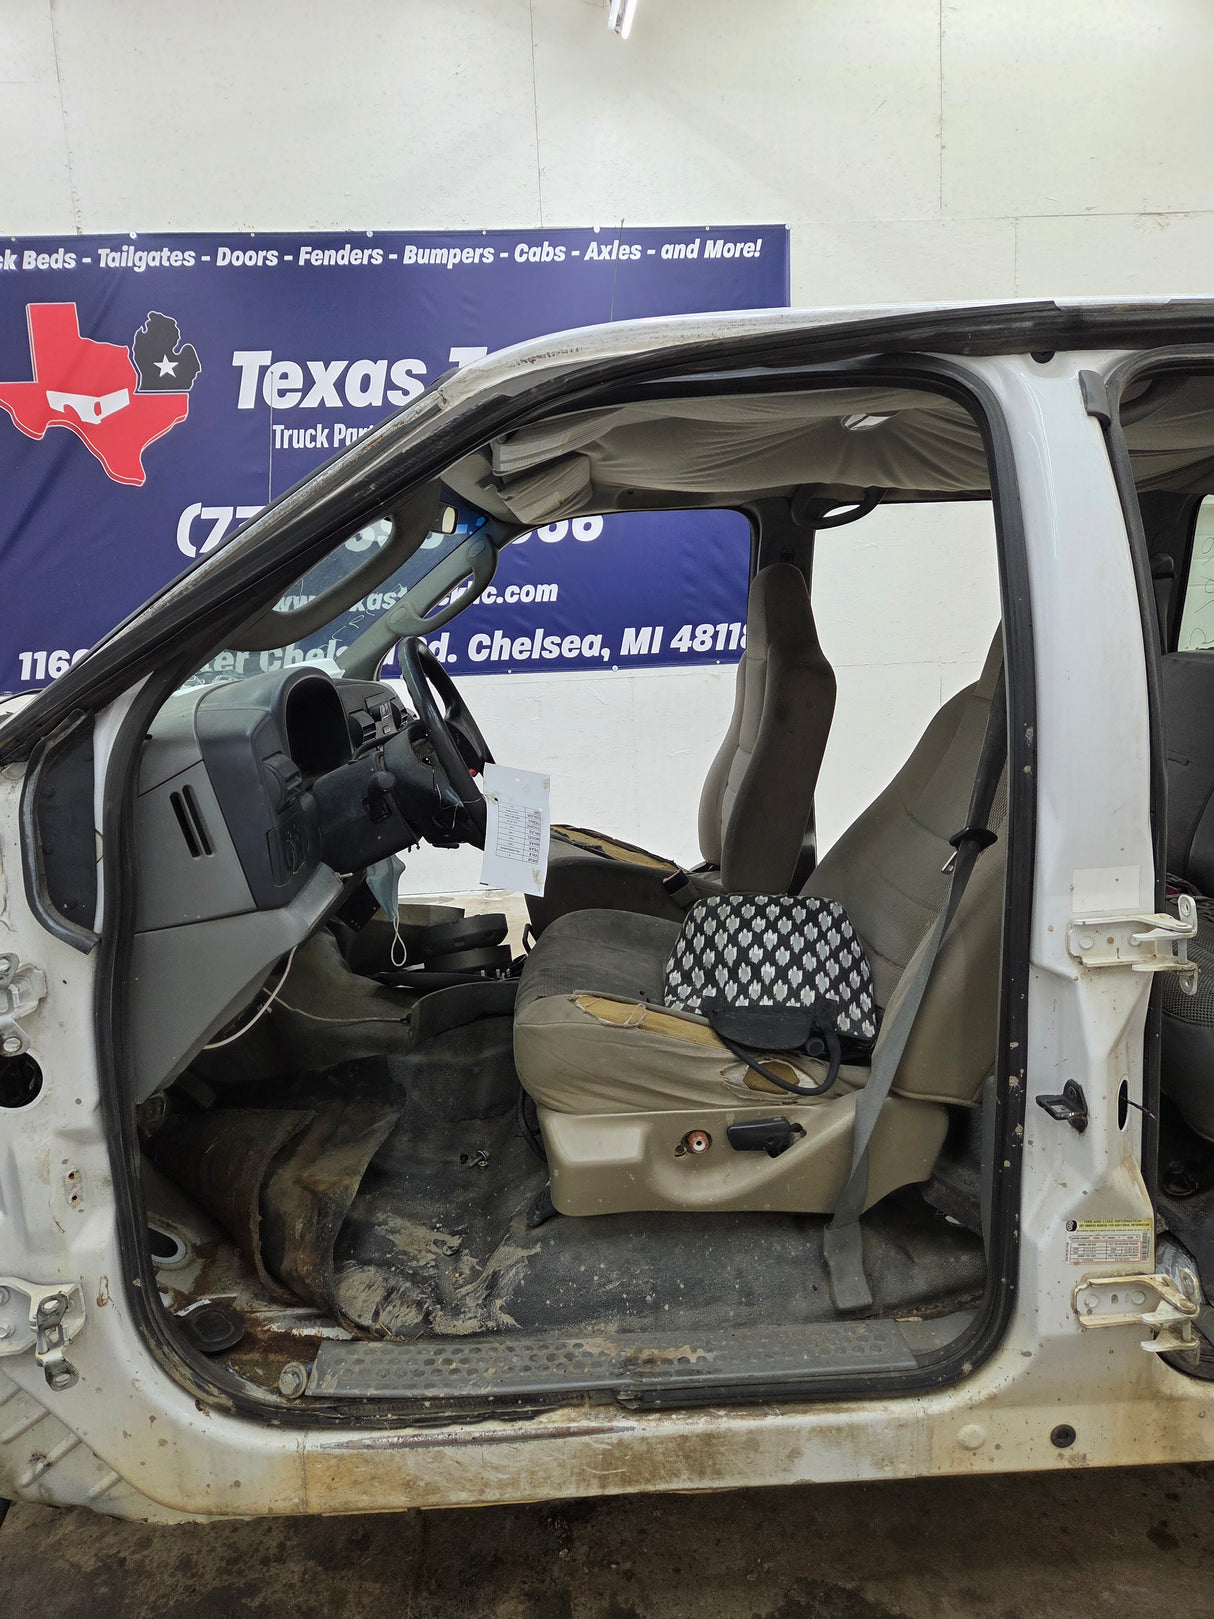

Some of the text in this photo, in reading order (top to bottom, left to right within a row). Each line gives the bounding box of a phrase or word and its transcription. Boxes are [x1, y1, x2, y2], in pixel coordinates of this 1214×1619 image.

[22, 247, 77, 270] Beds
[97, 244, 196, 272] Tailgates
[216, 246, 279, 267] Doors
[299, 244, 384, 266] Fenders
[402, 244, 495, 269] Bumpers
[514, 241, 567, 262] Cabs
[584, 240, 643, 261] Axles
[660, 239, 700, 259] and
[704, 238, 763, 259] More!
[232, 350, 428, 409] Texas
[272, 423, 330, 449] Truck
[467, 628, 611, 662] Chelsea,
[620, 625, 664, 656] MI
